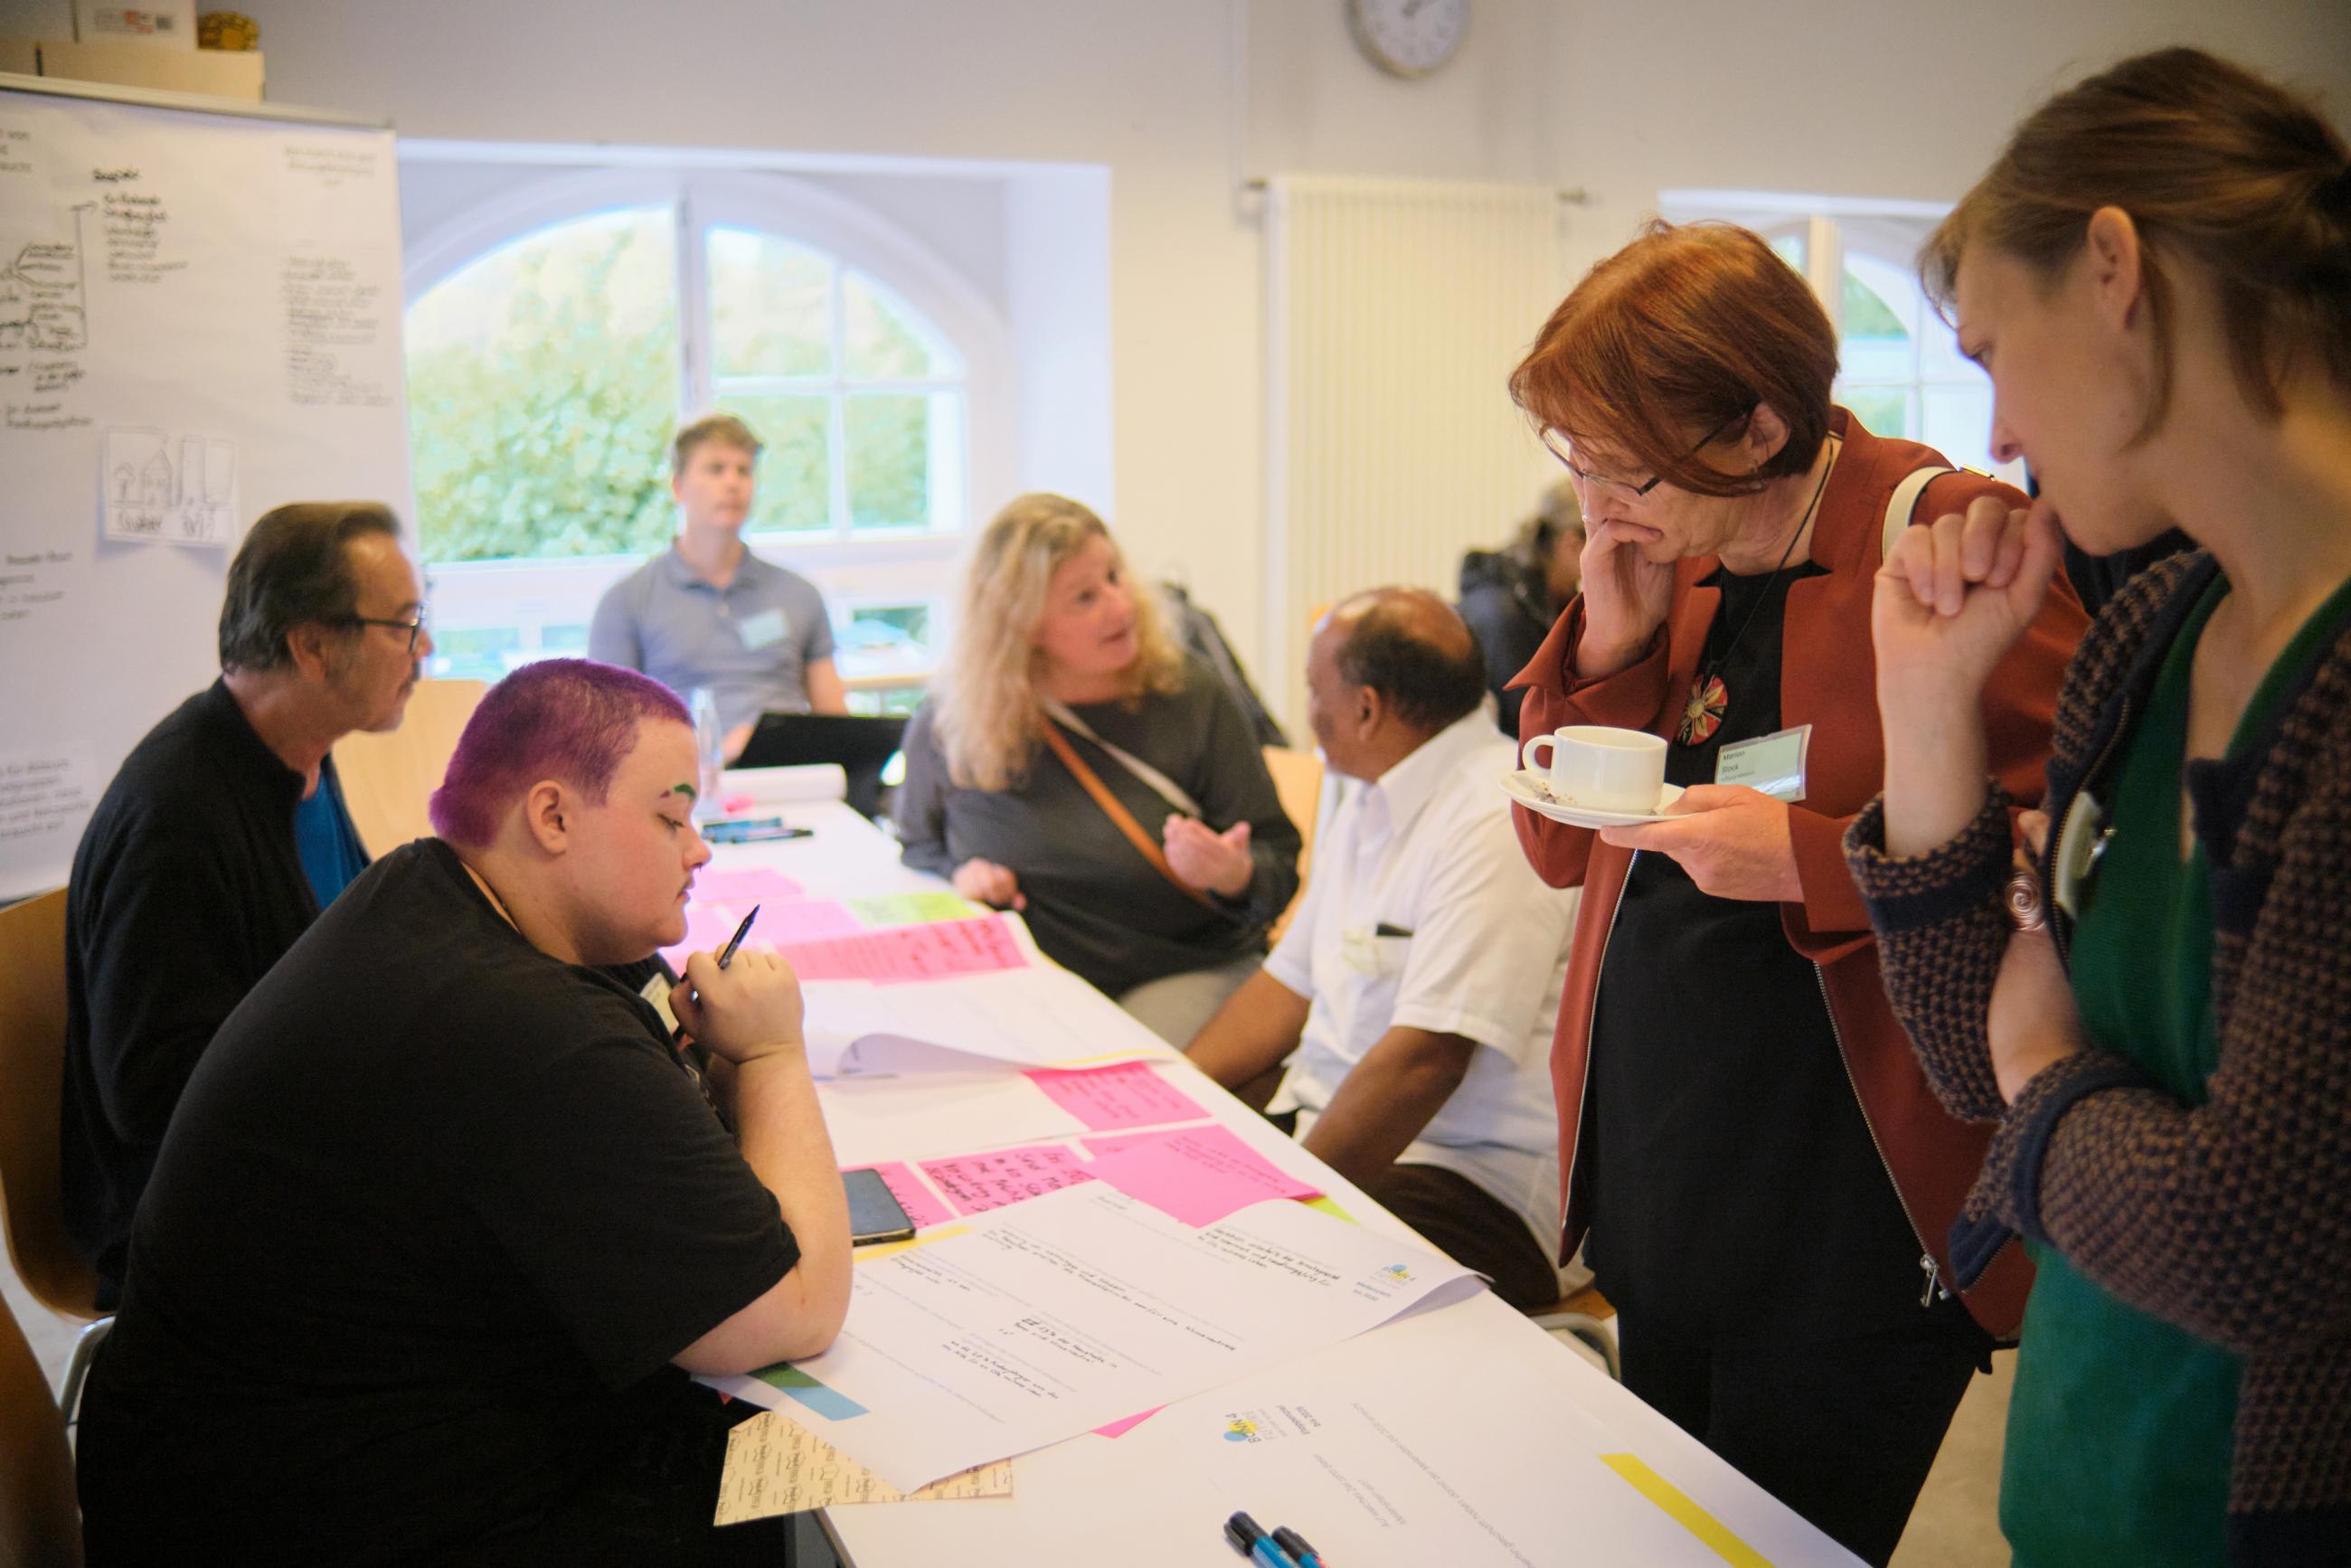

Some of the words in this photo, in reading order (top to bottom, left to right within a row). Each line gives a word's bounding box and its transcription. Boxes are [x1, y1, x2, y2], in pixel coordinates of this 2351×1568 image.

[1723, 751, 1745, 760] Marion
[1722, 764, 1739, 773] Stock
[1232, 1419, 1261, 1444] BONN
